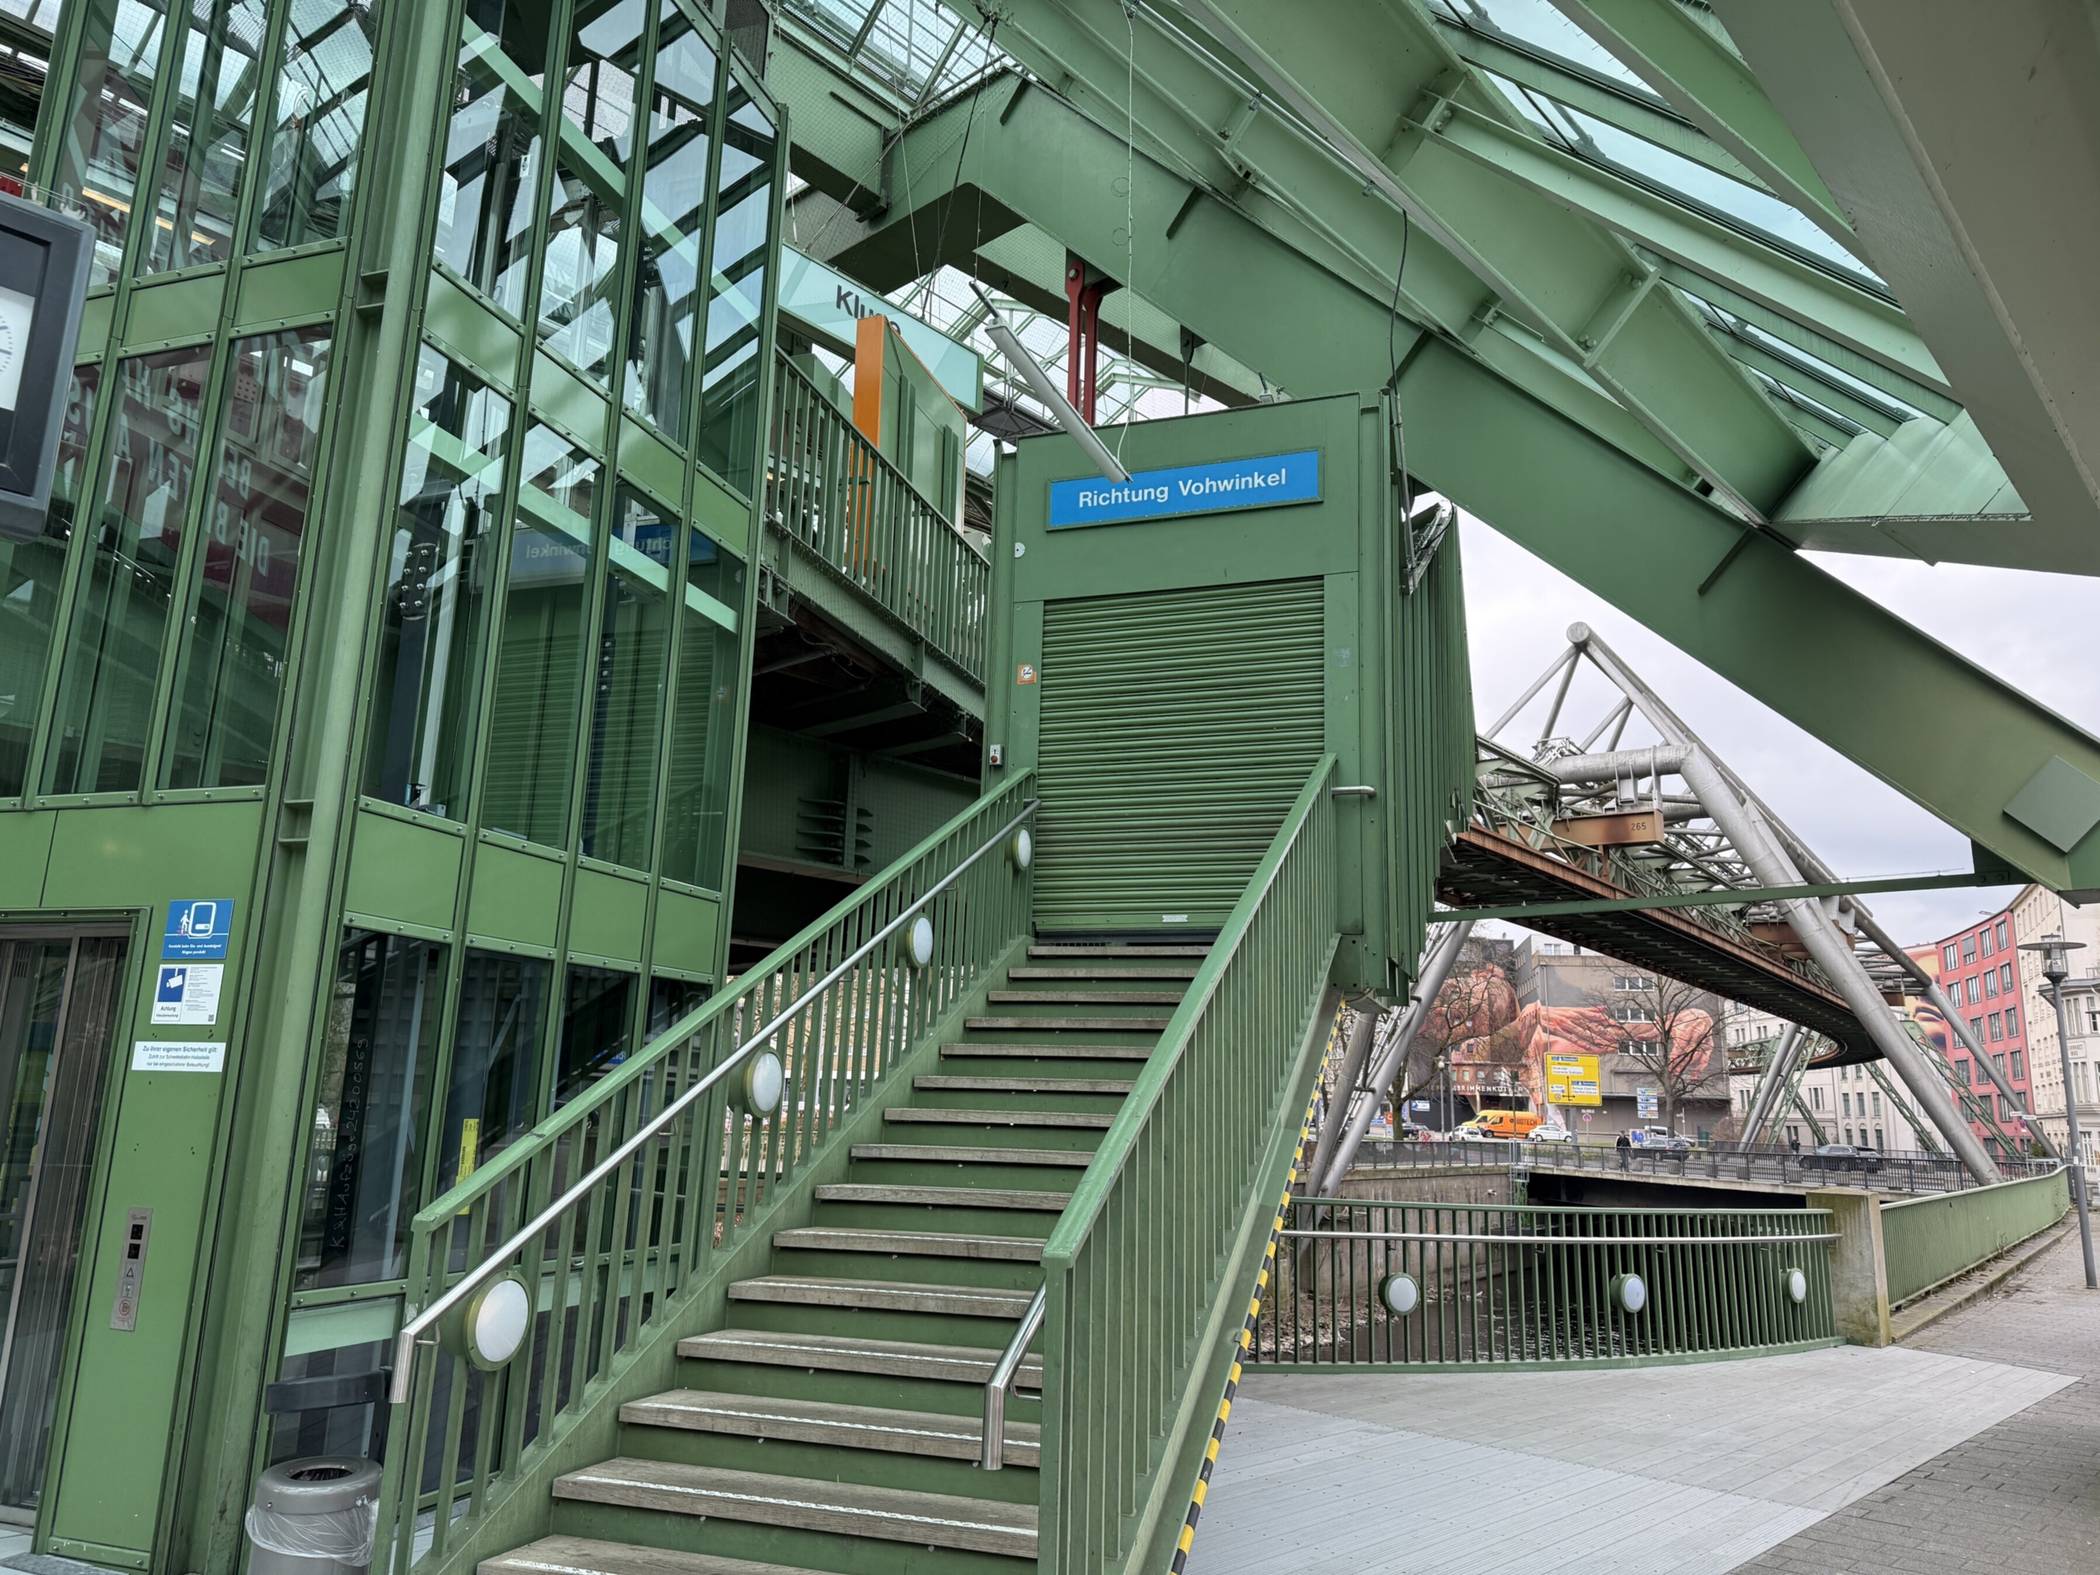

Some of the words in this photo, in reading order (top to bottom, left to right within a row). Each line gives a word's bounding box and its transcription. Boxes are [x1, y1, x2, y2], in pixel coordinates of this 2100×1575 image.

[1078, 484, 1169, 509] Richtung
[1179, 468, 1287, 497] Vohwinkel
[1631, 822, 1647, 831] 265
[183, 1045, 207, 1053] Sicherheit
